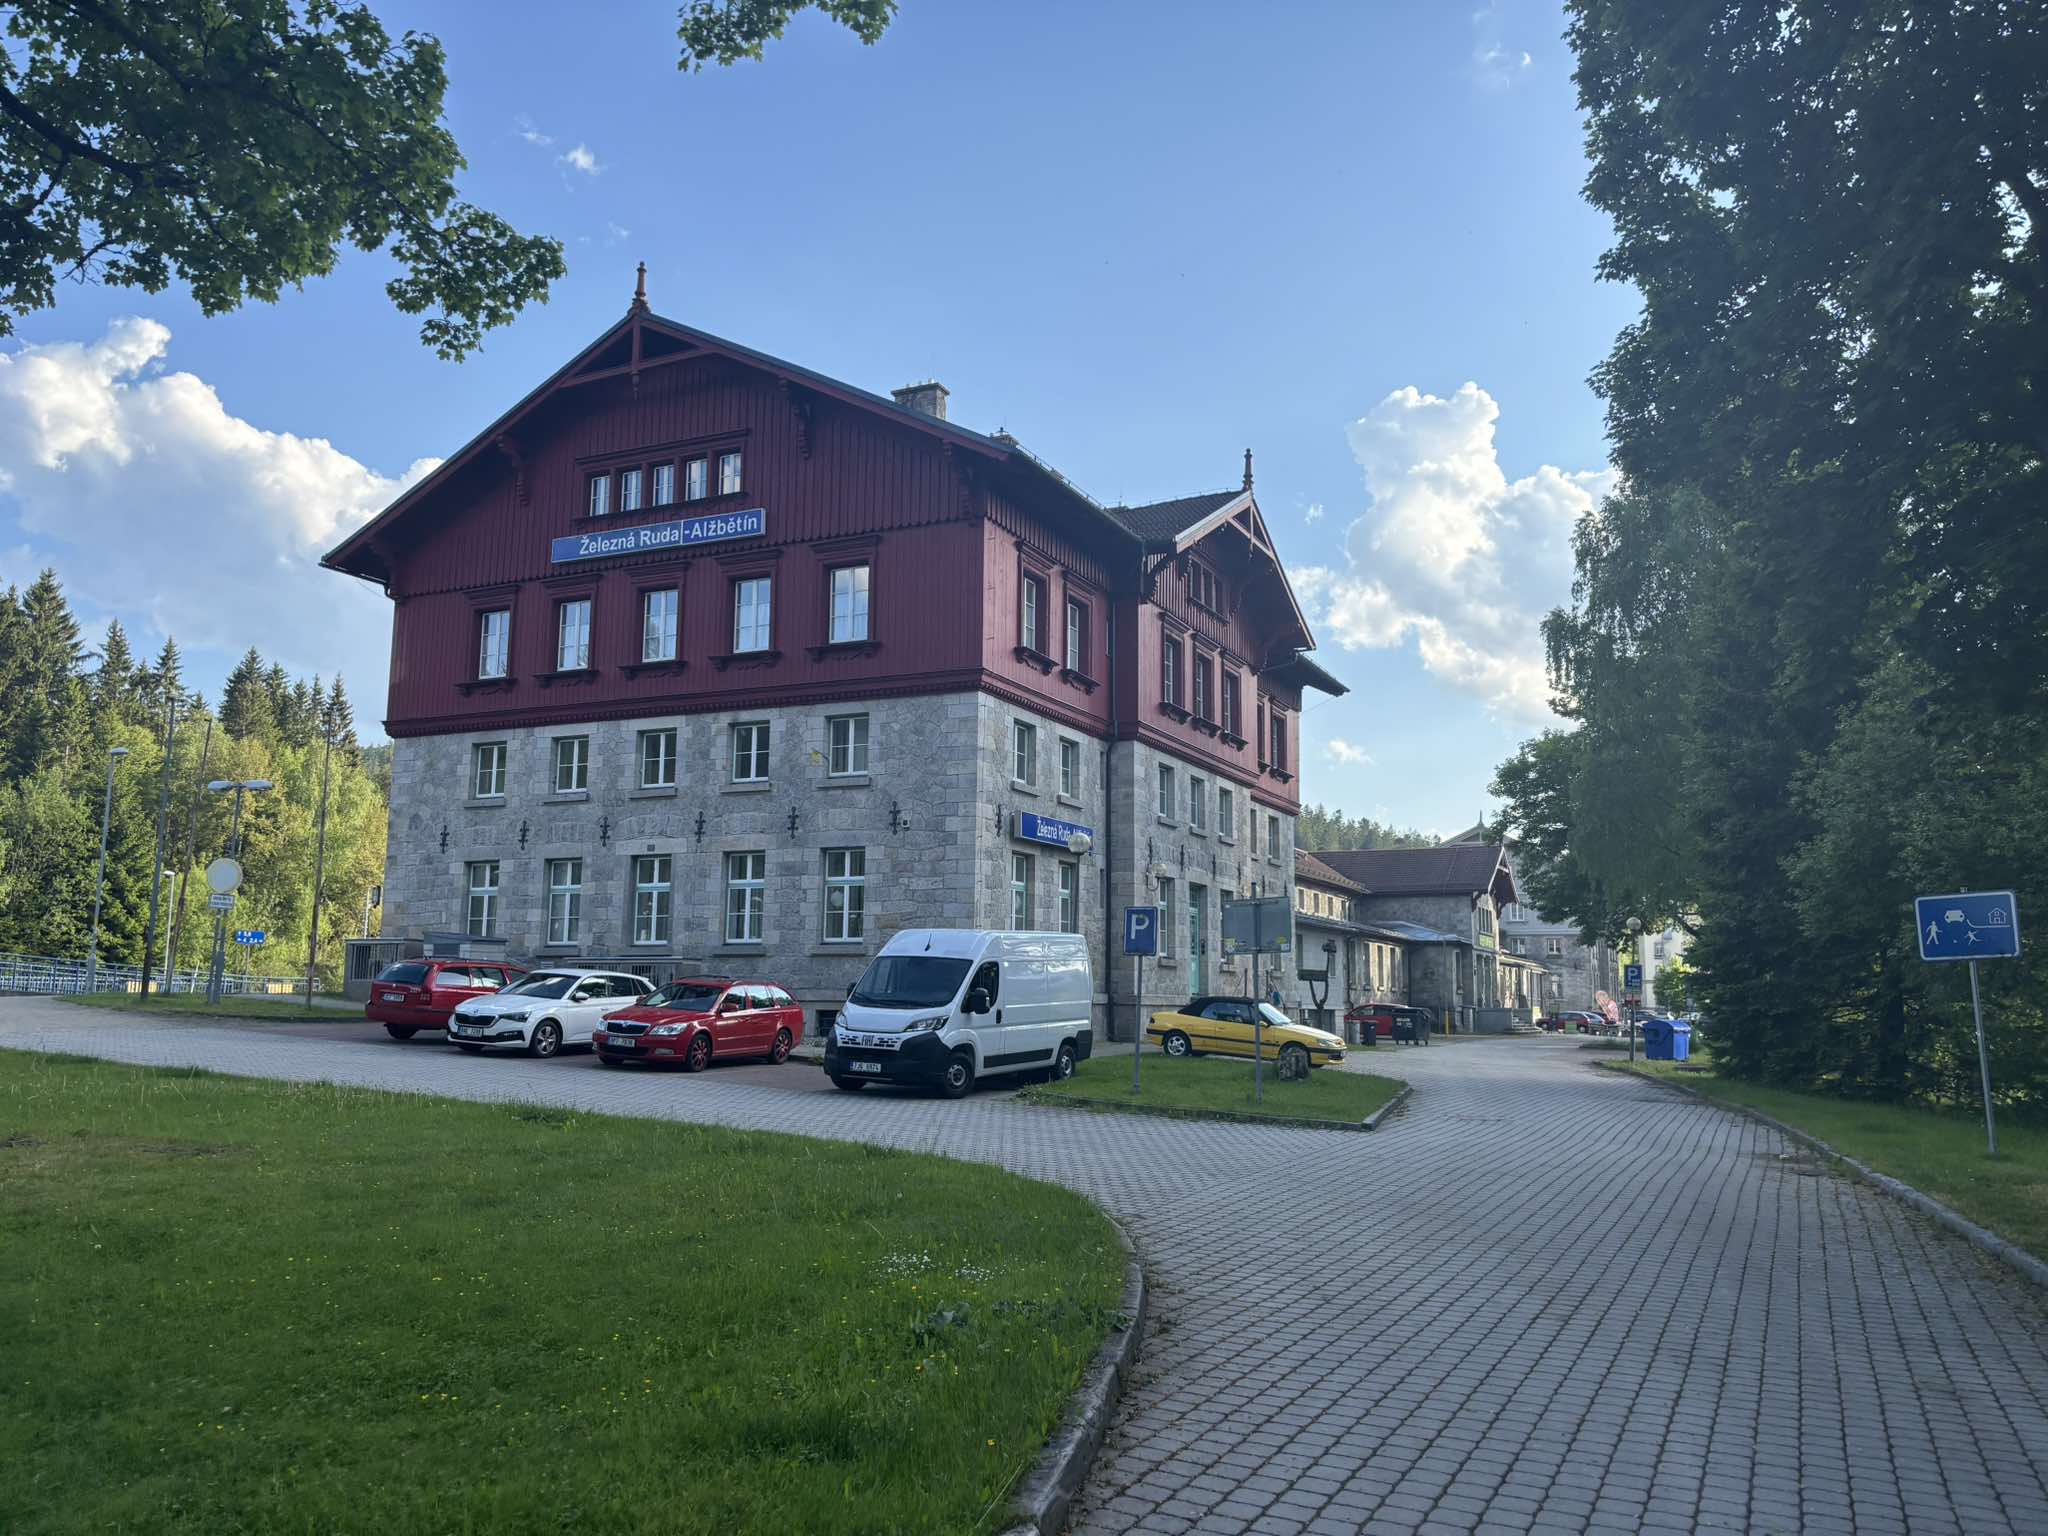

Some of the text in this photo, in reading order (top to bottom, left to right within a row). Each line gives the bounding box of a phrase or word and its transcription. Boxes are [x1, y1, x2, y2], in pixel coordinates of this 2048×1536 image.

[579, 533, 635, 554] Železná
[640, 527, 679, 547] Ruda
[1130, 914, 1150, 940] P
[1627, 967, 1638, 980] P
